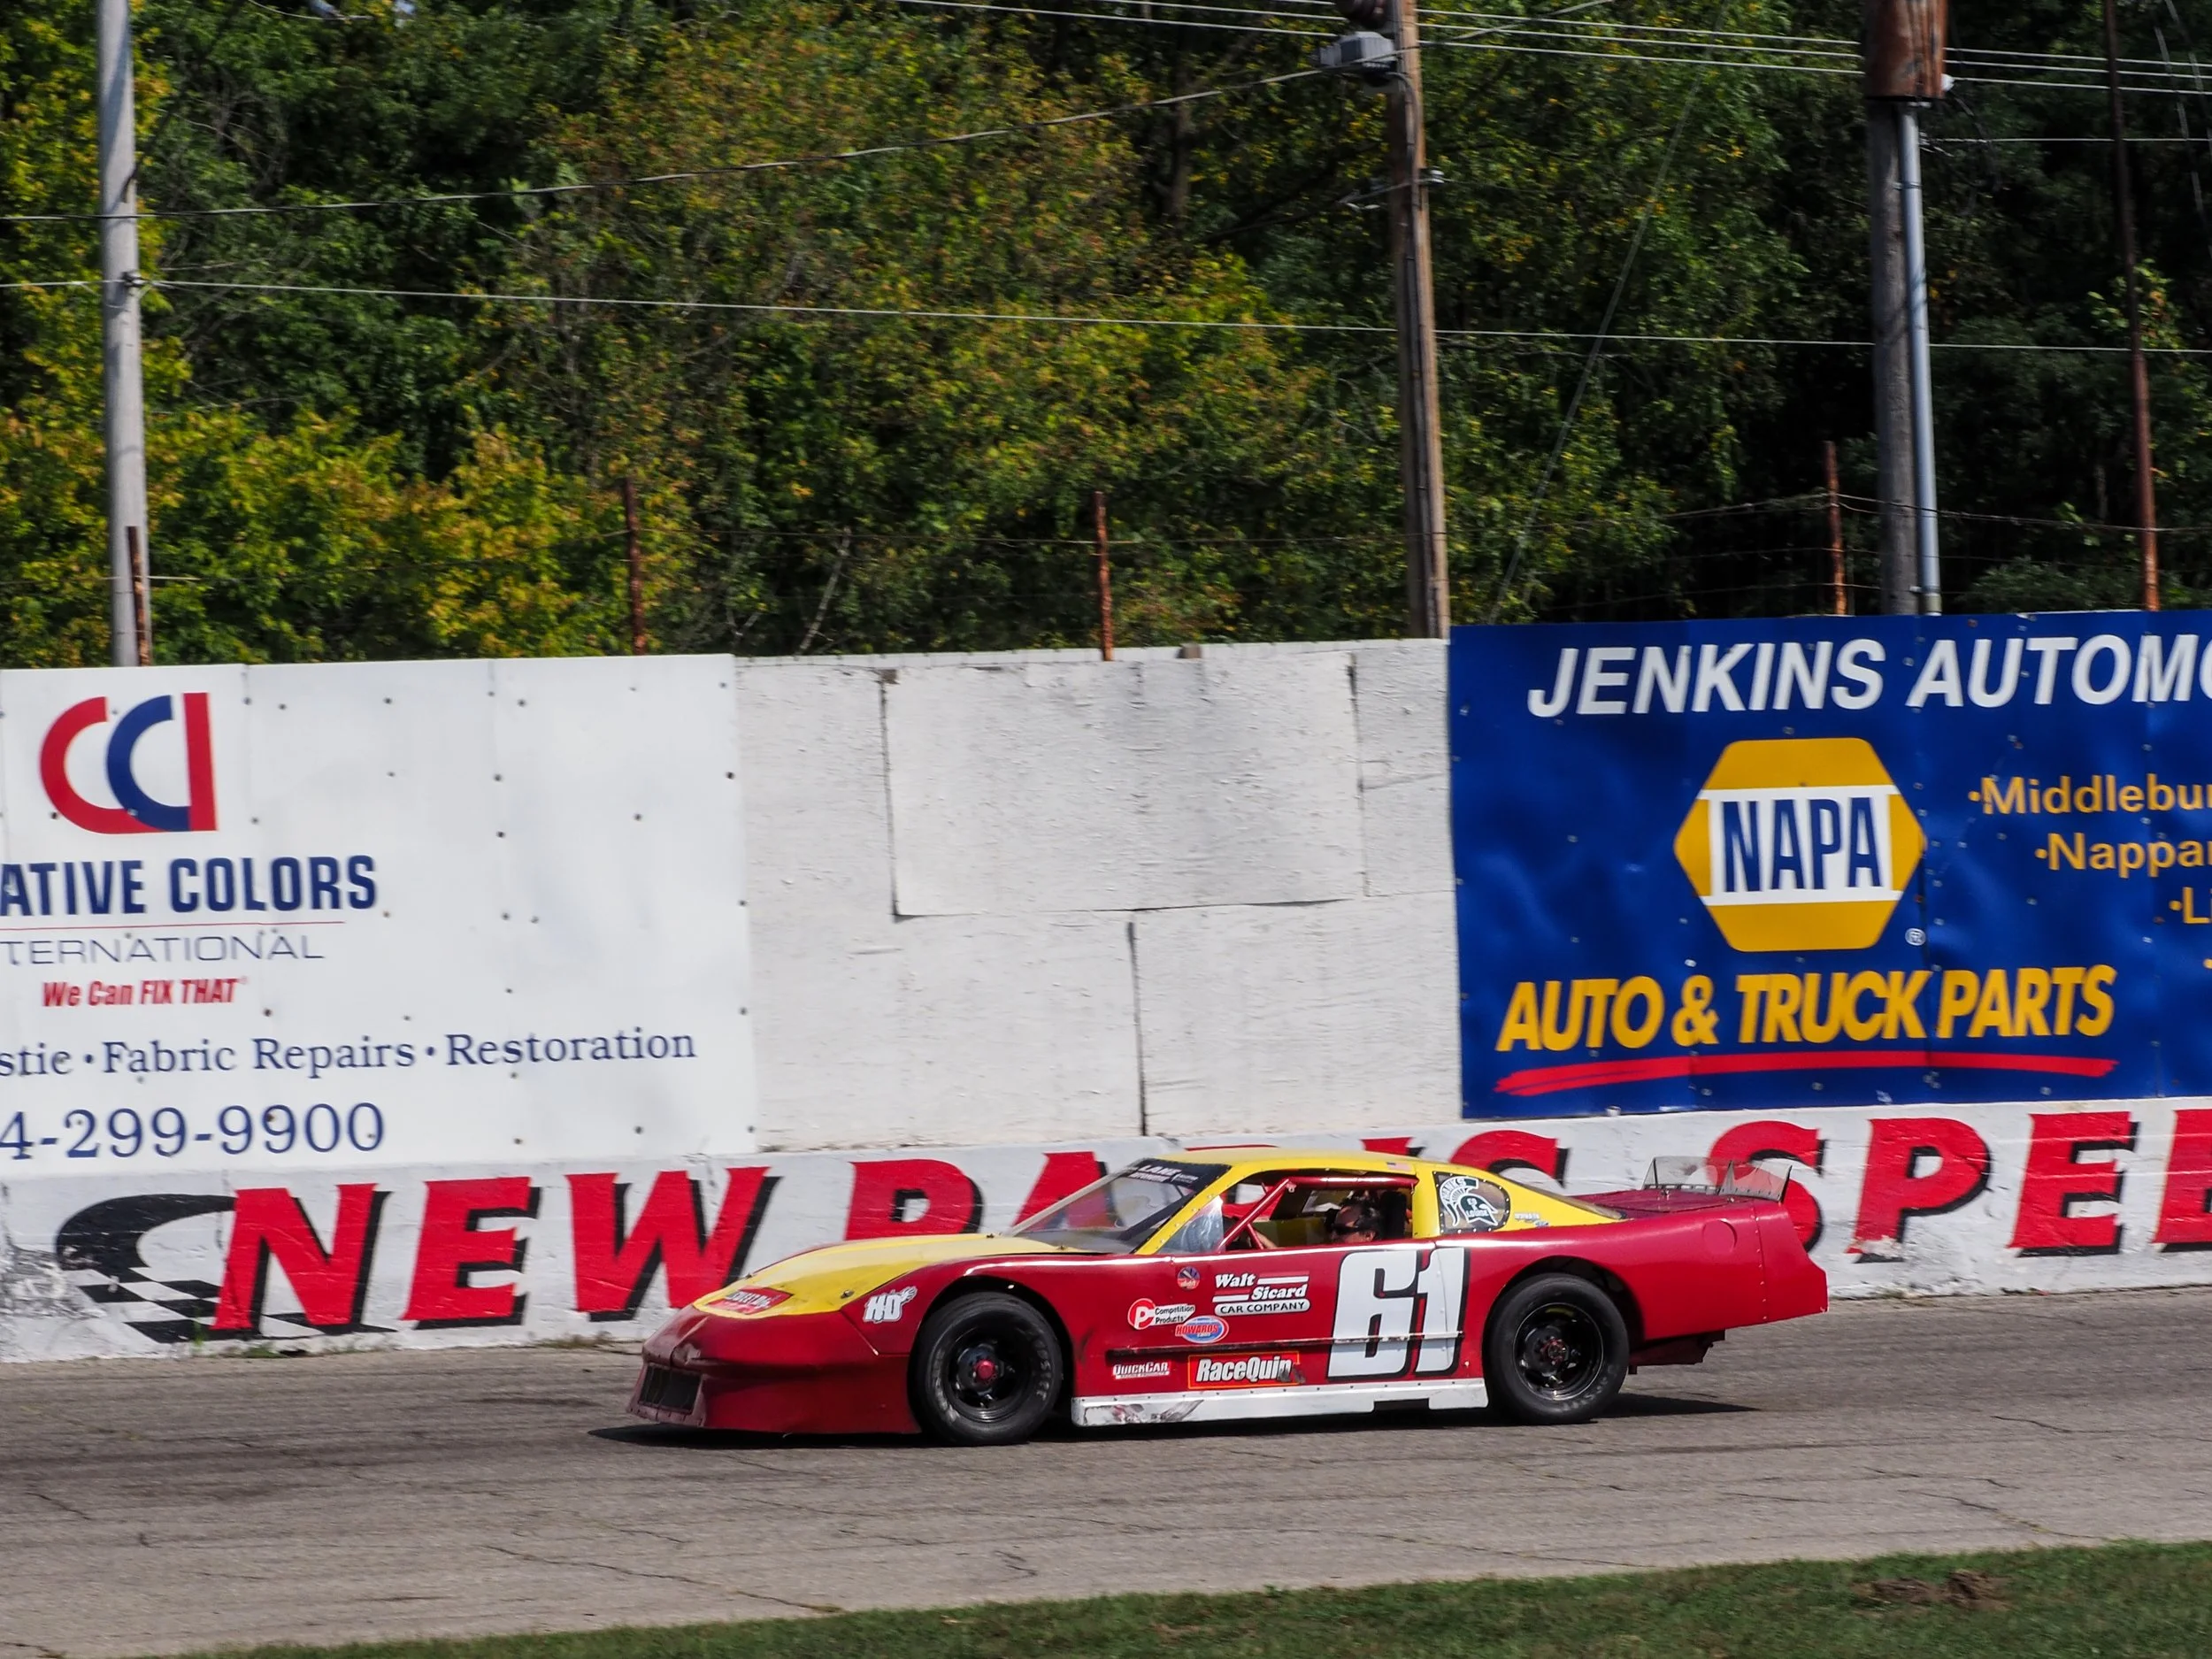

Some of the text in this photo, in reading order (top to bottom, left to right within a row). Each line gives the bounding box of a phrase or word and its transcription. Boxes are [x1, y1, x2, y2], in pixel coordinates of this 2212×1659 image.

[1527, 634, 2212, 718] JENKINS AUTOM
[1724, 796, 1882, 893] NAPA
[169, 855, 378, 912] COLORS
[2182, 887, 2212, 924] L
[0, 934, 325, 965] TERNATIONAL
[42, 978, 240, 1007] We Can FIX THAT
[1496, 965, 2117, 1051] AUTO & TRUCK PARTS
[102, 1037, 236, 1073] Fabric
[251, 1032, 416, 1079] Repairs
[446, 1026, 697, 1066] Restoration
[0, 1102, 385, 1160] 4-299-9900
[211, 1166, 775, 1332] NEW
[1215, 1272, 1256, 1289] Walt
[1250, 1284, 1309, 1301] Sicard
[1155, 1304, 1194, 1316] Competition
[1155, 1315, 1185, 1325] Products
[1220, 1302, 1306, 1314] CAR COMPANY
[1327, 1246, 1470, 1379] 61
[1175, 1325, 1219, 1337] HOWARDS
